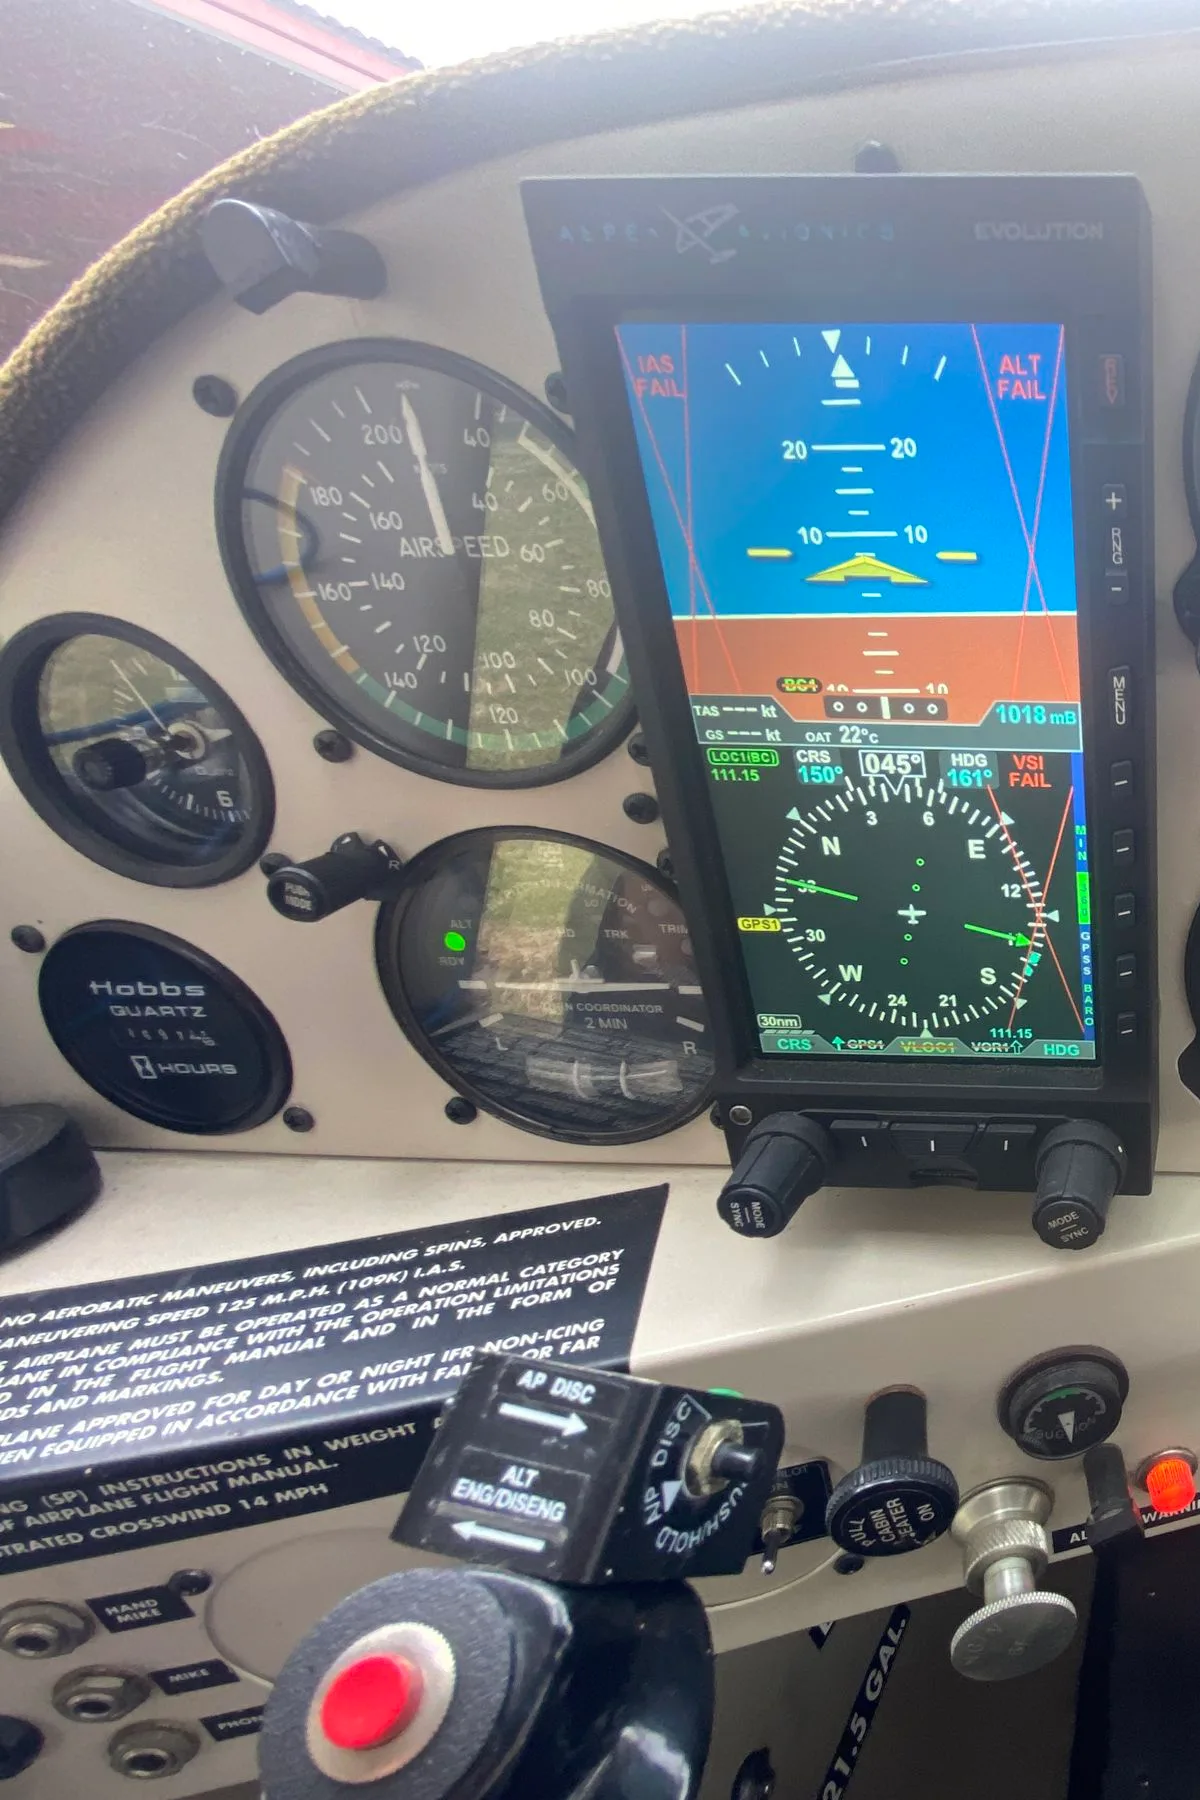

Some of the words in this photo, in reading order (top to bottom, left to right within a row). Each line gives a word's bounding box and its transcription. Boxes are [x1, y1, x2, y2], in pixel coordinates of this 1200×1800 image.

[974, 221, 1103, 241] EVOLUTION
[637, 356, 675, 374] IAS
[1000, 355, 1041, 374] ALT
[636, 378, 686, 398] FAIL
[997, 379, 1047, 399] FAIL
[362, 426, 403, 445] 200
[782, 441, 808, 460] 20
[891, 438, 917, 458] 20
[798, 526, 824, 545] 10
[904, 525, 928, 544] 10
[369, 572, 405, 591] 140
[1113, 677, 1126, 724] MENU
[796, 750, 831, 763] CRS
[864, 752, 921, 775] 045°
[950, 753, 988, 767] HDG
[1012, 754, 1044, 770] VSI
[711, 768, 760, 782] 111.15
[798, 765, 843, 784] 150°
[947, 769, 993, 787] 161°
[1008, 772, 1052, 788] FAIL
[822, 836, 841, 856] N
[968, 839, 986, 859] E
[839, 965, 863, 981] W
[980, 967, 997, 984] S
[89, 980, 206, 996] Hobbs
[109, 1005, 207, 1018] QUARTZ
[760, 1016, 798, 1027] 30nm
[777, 1039, 812, 1051] CRS
[1043, 1044, 1080, 1056] HDG
[158, 1063, 238, 1075] HOURS
[1, 1313, 36, 1329] NO
[40, 1294, 158, 1322] AEROBATIC
[160, 1270, 297, 1303] MANEUVERS,
[303, 1248, 418, 1278] INCLUDING
[424, 1237, 487, 1257] SPINS,
[492, 1216, 602, 1244] APPROVED.
[0, 1318, 140, 1349] ANEUVERING
[143, 1306, 210, 1327] SPEED
[216, 1297, 258, 1315] 125
[262, 1284, 330, 1306] M.P.H.
[336, 1270, 409, 1295] (109K)
[413, 1260, 466, 1278] I.A.S.
[12, 1342, 123, 1371] AIRPLANE
[127, 1329, 195, 1352] MUST
[199, 1324, 229, 1339] BE
[234, 1302, 346, 1333] OPERATED
[354, 1295, 385, 1311] AS
[391, 1291, 409, 1304] A
[417, 1272, 510, 1299] NORMAL
[518, 1249, 625, 1279] CATEGORY
[57, 1363, 85, 1379] IN
[93, 1337, 238, 1373] COMPLIANCE
[246, 1325, 305, 1345] WITH
[313, 1315, 353, 1333] THE
[360, 1291, 485, 1324] OPERATION
[492, 1263, 621, 1299] LIMITATIONS
[67, 1400, 196, 1435] APPROVED
[202, 1391, 252, 1410] FOR
[257, 1377, 313, 1400] DAY
[317, 1370, 353, 1388] OR
[359, 1353, 436, 1380] NIGHT
[440, 1345, 476, 1363] IFR
[481, 1318, 605, 1352] NON-ICING
[517, 1370, 548, 1388] AP
[549, 1377, 596, 1405] DISC
[501, 1465, 540, 1488] ALT
[25, 1497, 137, 1528] AIRPLANE
[142, 1480, 219, 1505] FLIGHT
[227, 1459, 340, 1488] MANUAL.
[452, 1477, 567, 1523] ENG/DISENG
[90, 1503, 232, 1539] CROSSWIND
[238, 1494, 269, 1510] 14
[275, 1483, 328, 1503] MPH
[105, 1599, 158, 1615] HAND
[116, 1609, 162, 1624] MIKE
[823, 1712, 867, 1800] 21.5
[865, 1619, 907, 1701] GAL.
